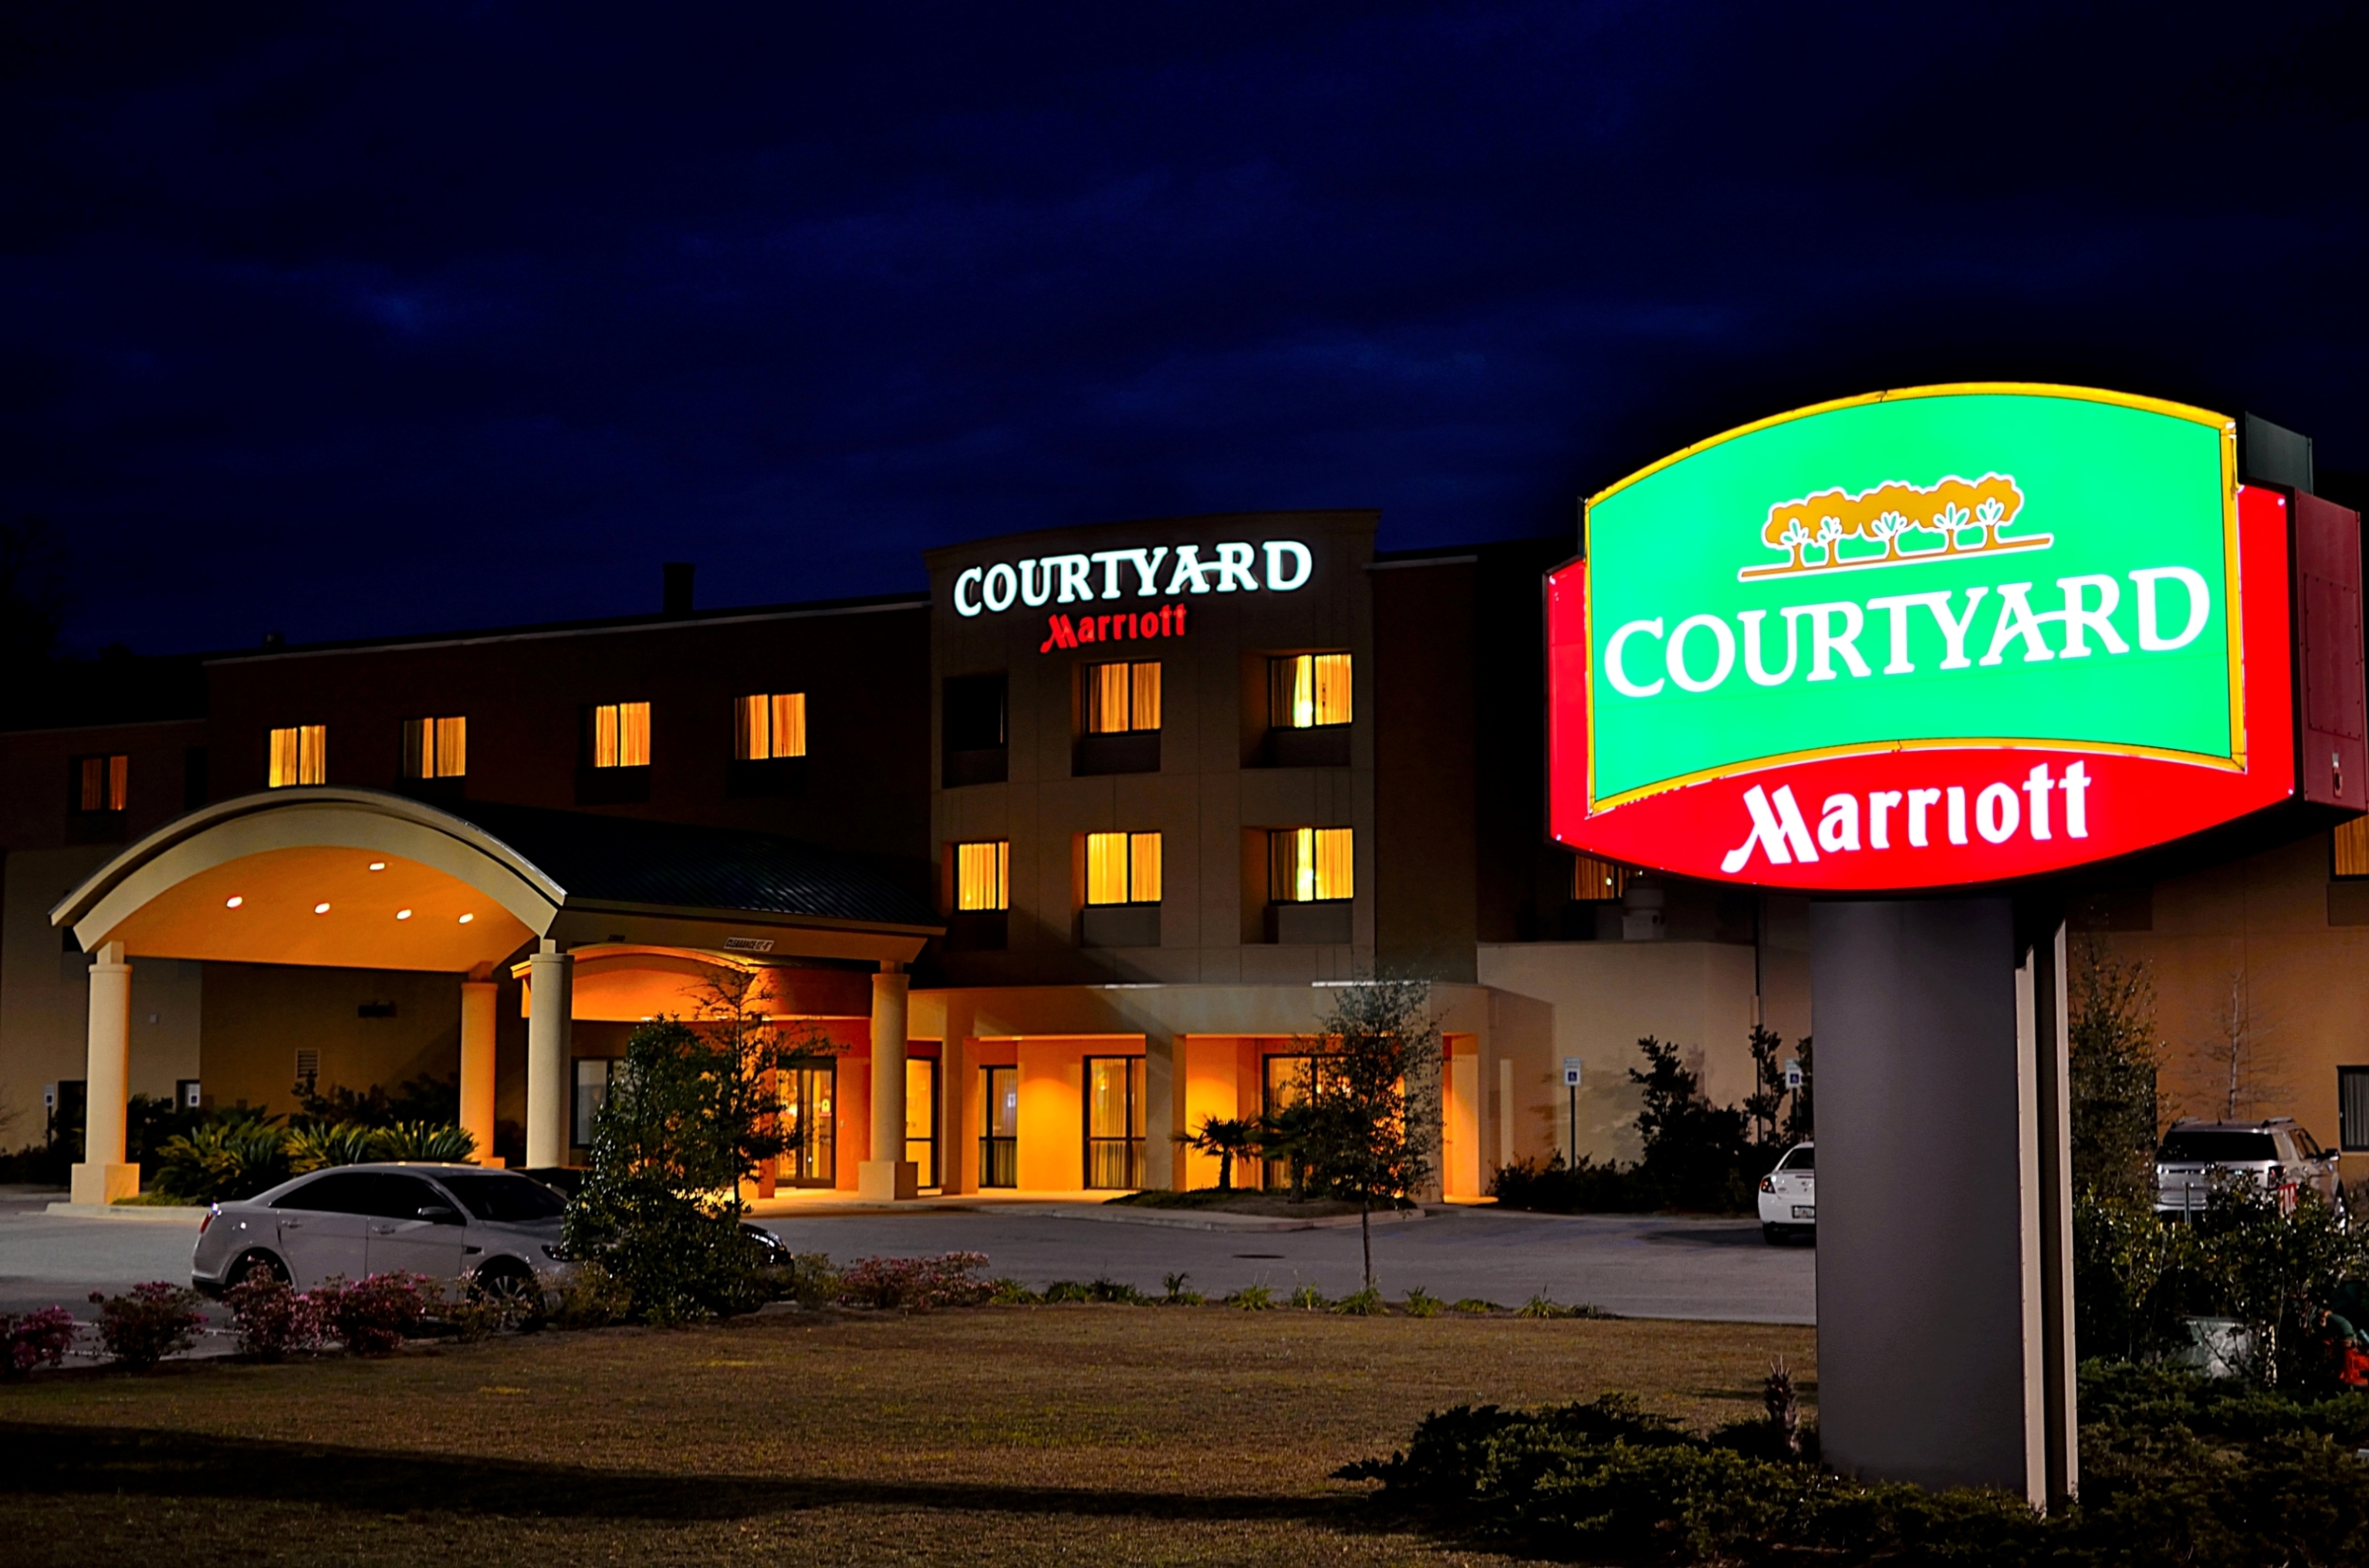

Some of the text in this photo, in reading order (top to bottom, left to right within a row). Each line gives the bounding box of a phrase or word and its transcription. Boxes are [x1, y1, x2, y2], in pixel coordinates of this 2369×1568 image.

[954, 541, 1313, 617] COURTYARD
[1039, 603, 1188, 654] Marriott
[1604, 566, 2211, 698] COURTYARD
[1720, 760, 2092, 874] Marriott
